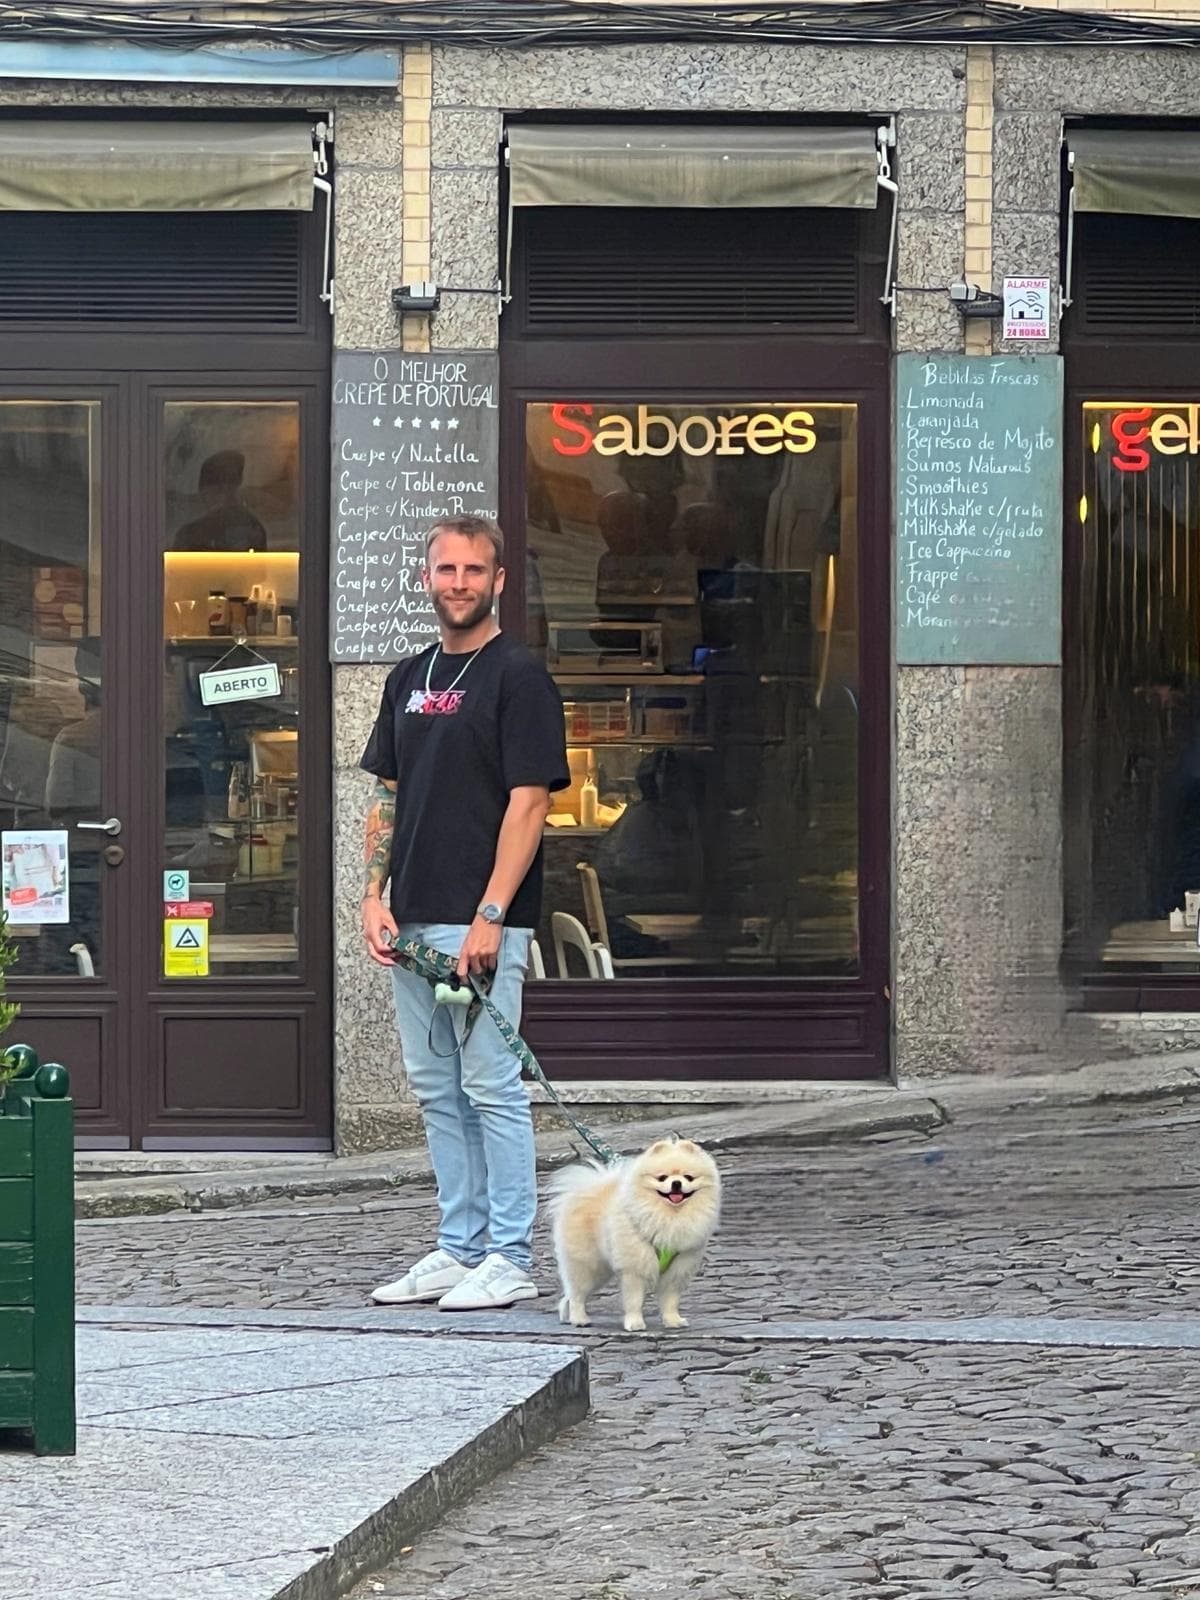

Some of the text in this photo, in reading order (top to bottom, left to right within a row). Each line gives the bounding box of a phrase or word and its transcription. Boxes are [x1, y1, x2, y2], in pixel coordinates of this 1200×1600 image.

[1007, 280, 1047, 289] ALARME
[1007, 328, 1046, 337] 24 HORAS
[374, 357, 467, 383] O MELHOR
[921, 362, 984, 387] Bebidas
[333, 379, 498, 408] CREPE DE PORTUGAL
[906, 387, 984, 409] Limonada
[552, 403, 817, 456] Sabores
[906, 411, 979, 436] Laranjada
[907, 426, 1054, 460] Refresco de Mojito
[1112, 407, 1200, 471] gel
[341, 438, 385, 467] Crepe
[410, 443, 479, 463] Nutella
[906, 449, 1031, 473] Sumos Naturais
[340, 470, 380, 496] Crepe
[401, 471, 486, 493] Toblerone
[905, 475, 988, 495] Smoothies
[339, 497, 380, 521] Crepe
[400, 497, 449, 519] Kinder
[905, 497, 982, 517] Milkshake
[904, 517, 976, 536] Milkshake
[337, 546, 379, 574] Crepe
[907, 540, 932, 560] Ice
[336, 569, 376, 597] Crepe
[906, 561, 960, 589] Frappé
[336, 594, 379, 621] Crepe
[906, 585, 941, 611] Café
[336, 615, 378, 639] Crepe
[335, 636, 374, 660] Crepe
[214, 677, 267, 694] ABERTO
